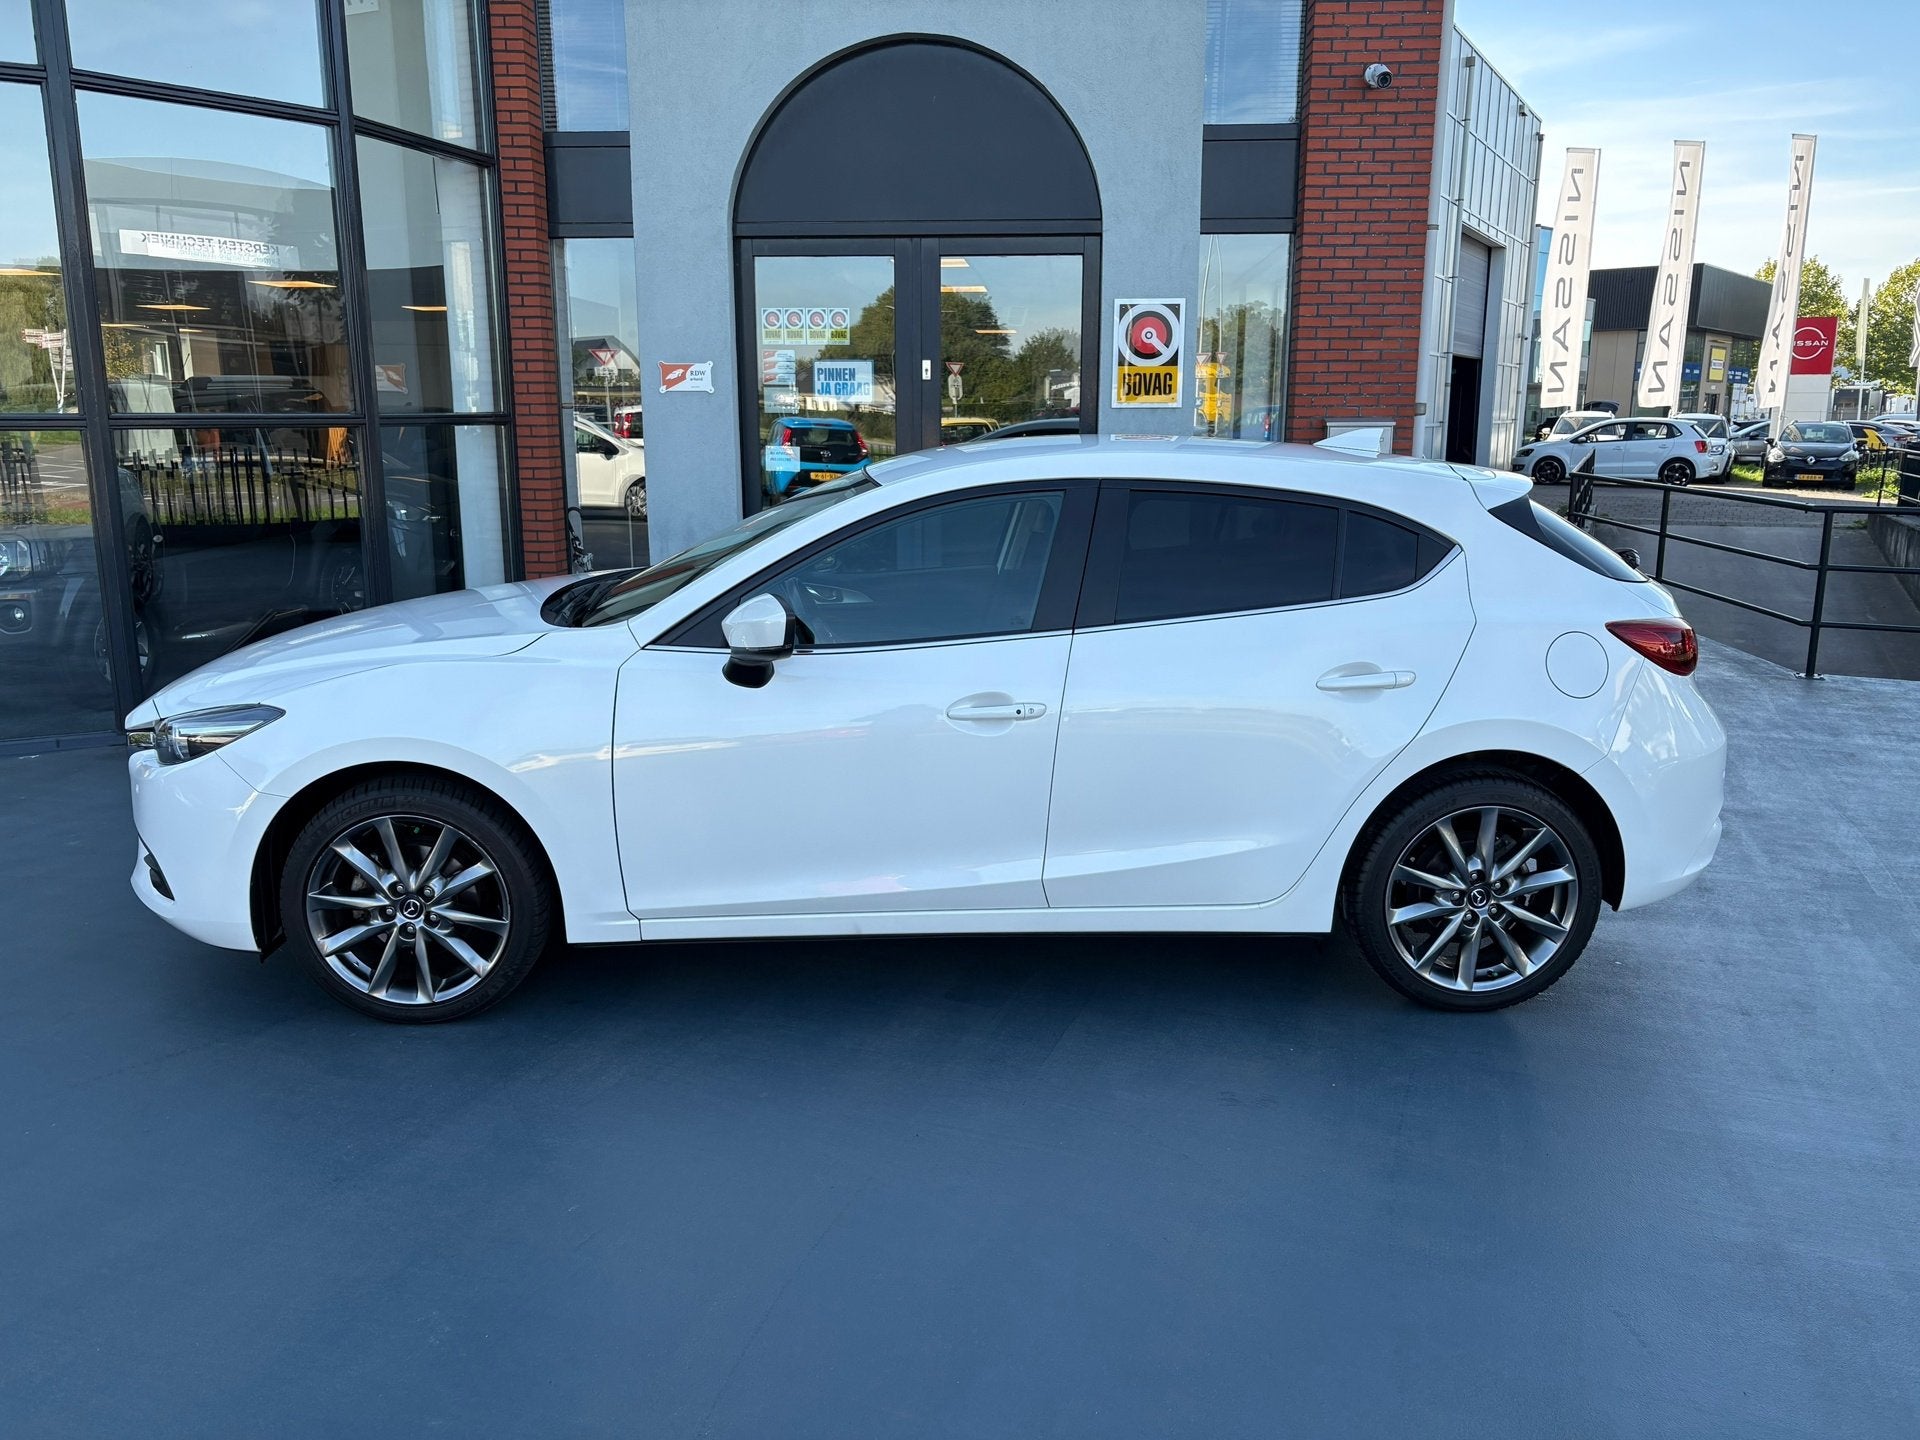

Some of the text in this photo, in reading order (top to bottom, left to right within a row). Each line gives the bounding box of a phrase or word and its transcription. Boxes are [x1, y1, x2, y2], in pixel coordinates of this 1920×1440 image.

[817, 368, 856, 381] PINNEN
[817, 382, 871, 395] JA GRAAG
[1123, 373, 1173, 396] BOVAG
